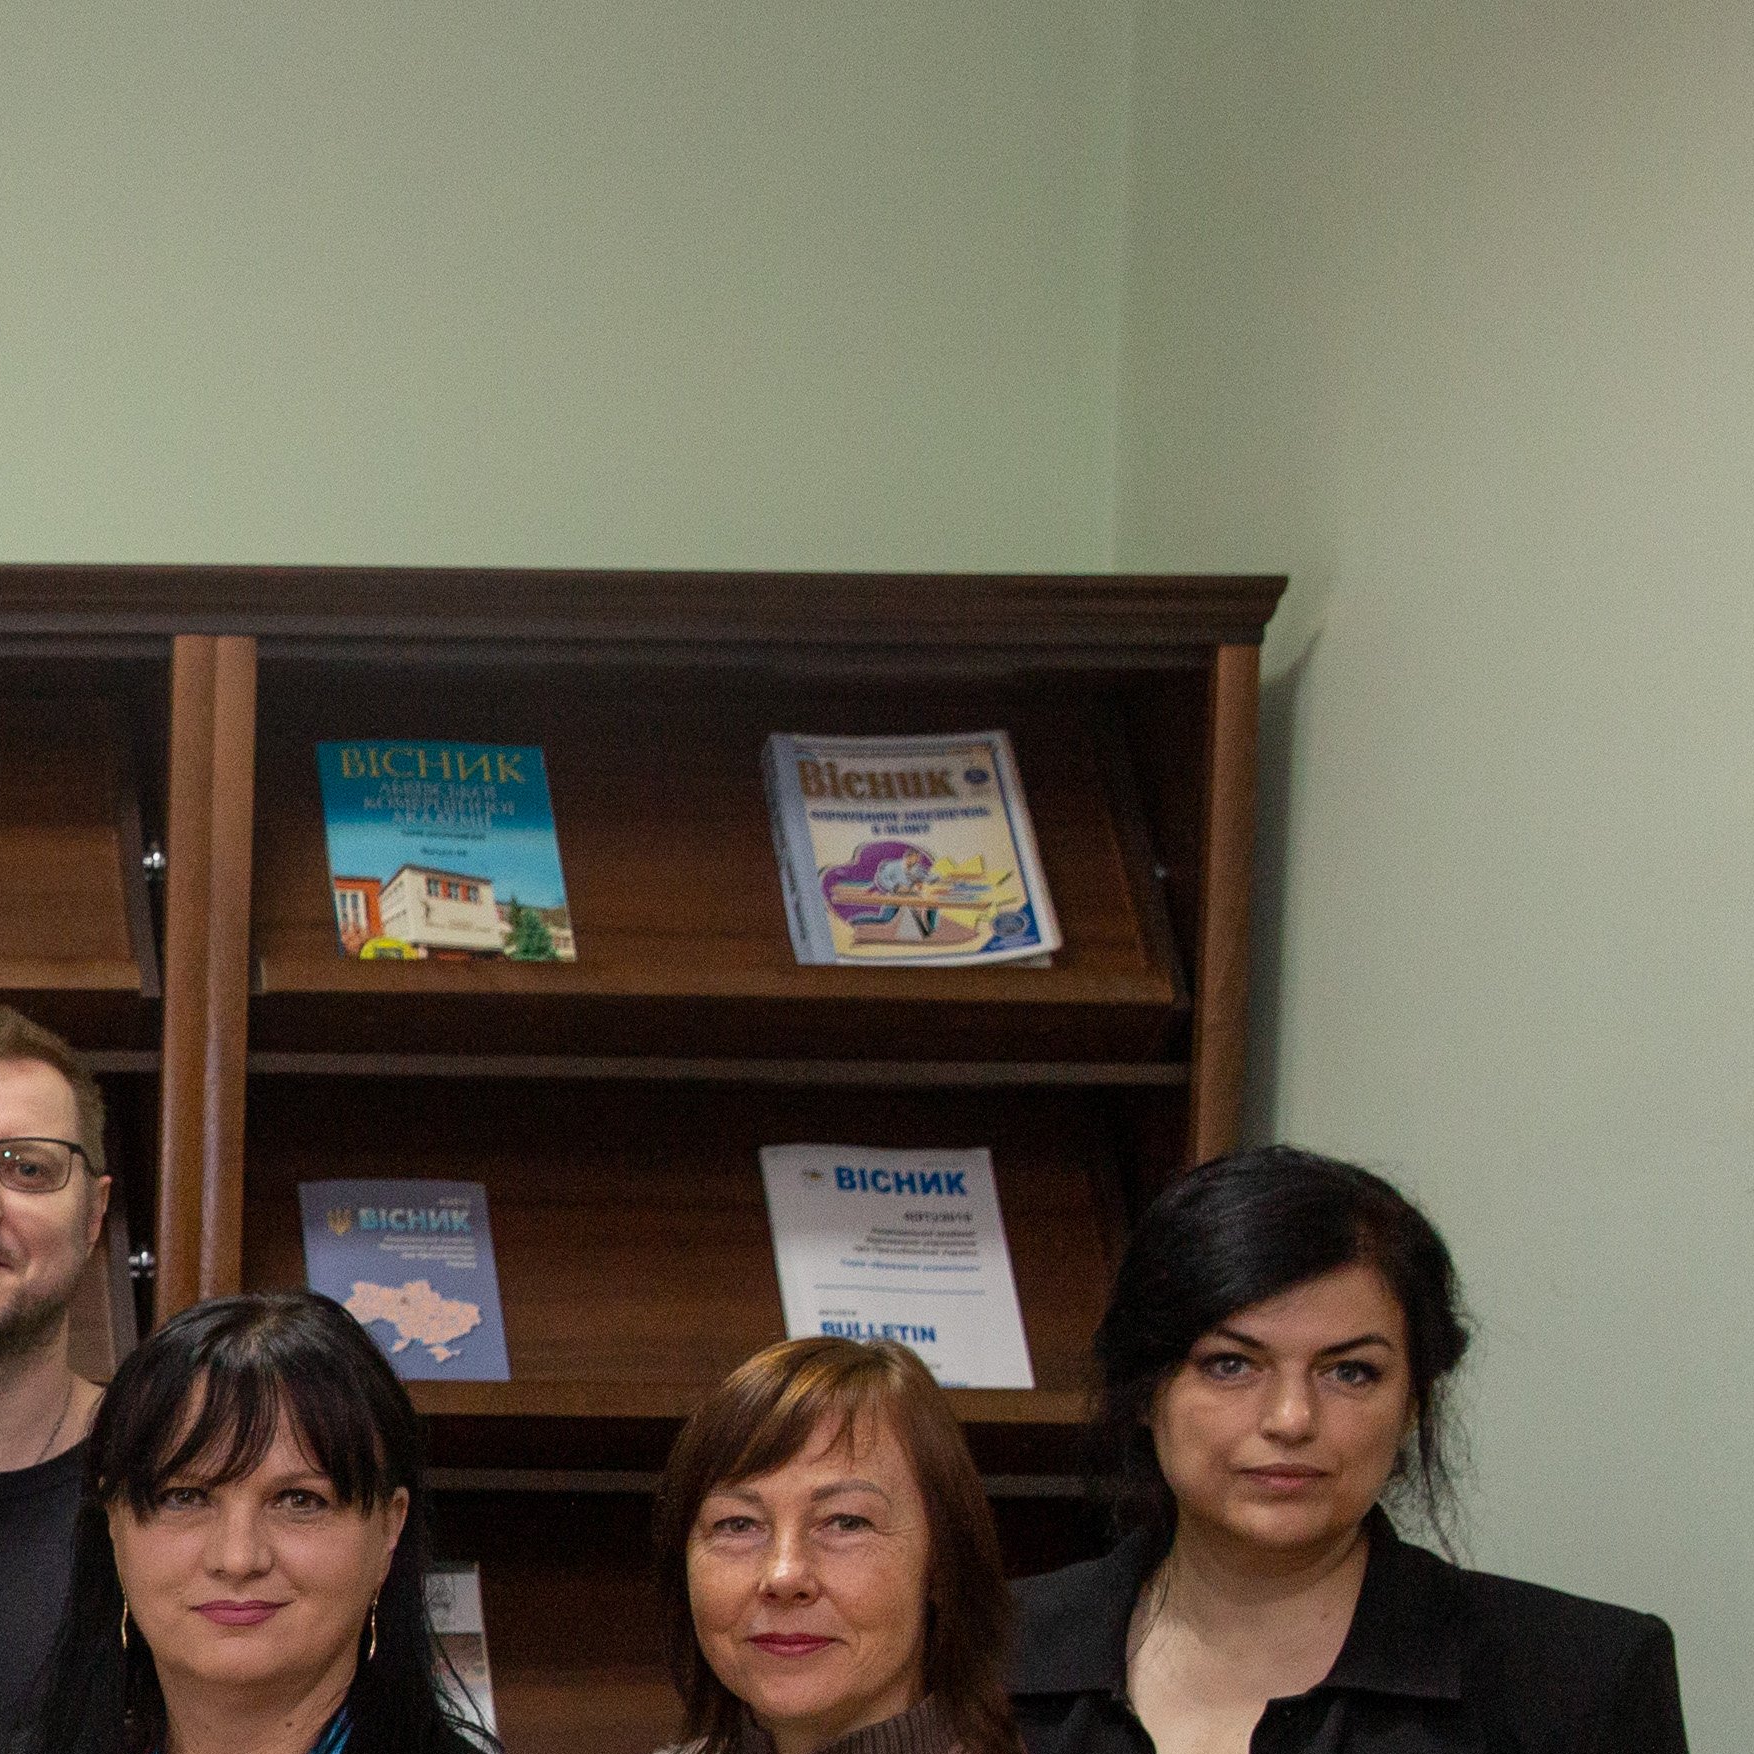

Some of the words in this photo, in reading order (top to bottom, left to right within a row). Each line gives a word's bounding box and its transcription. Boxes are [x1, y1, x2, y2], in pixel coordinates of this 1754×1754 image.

[342, 747, 527, 784] ВІСНИК
[796, 760, 959, 799] Вісник
[833, 1166, 968, 1196] ВІСНИК
[358, 1208, 472, 1233] ВІСНИК
[820, 1320, 937, 1343] BULLETIN
